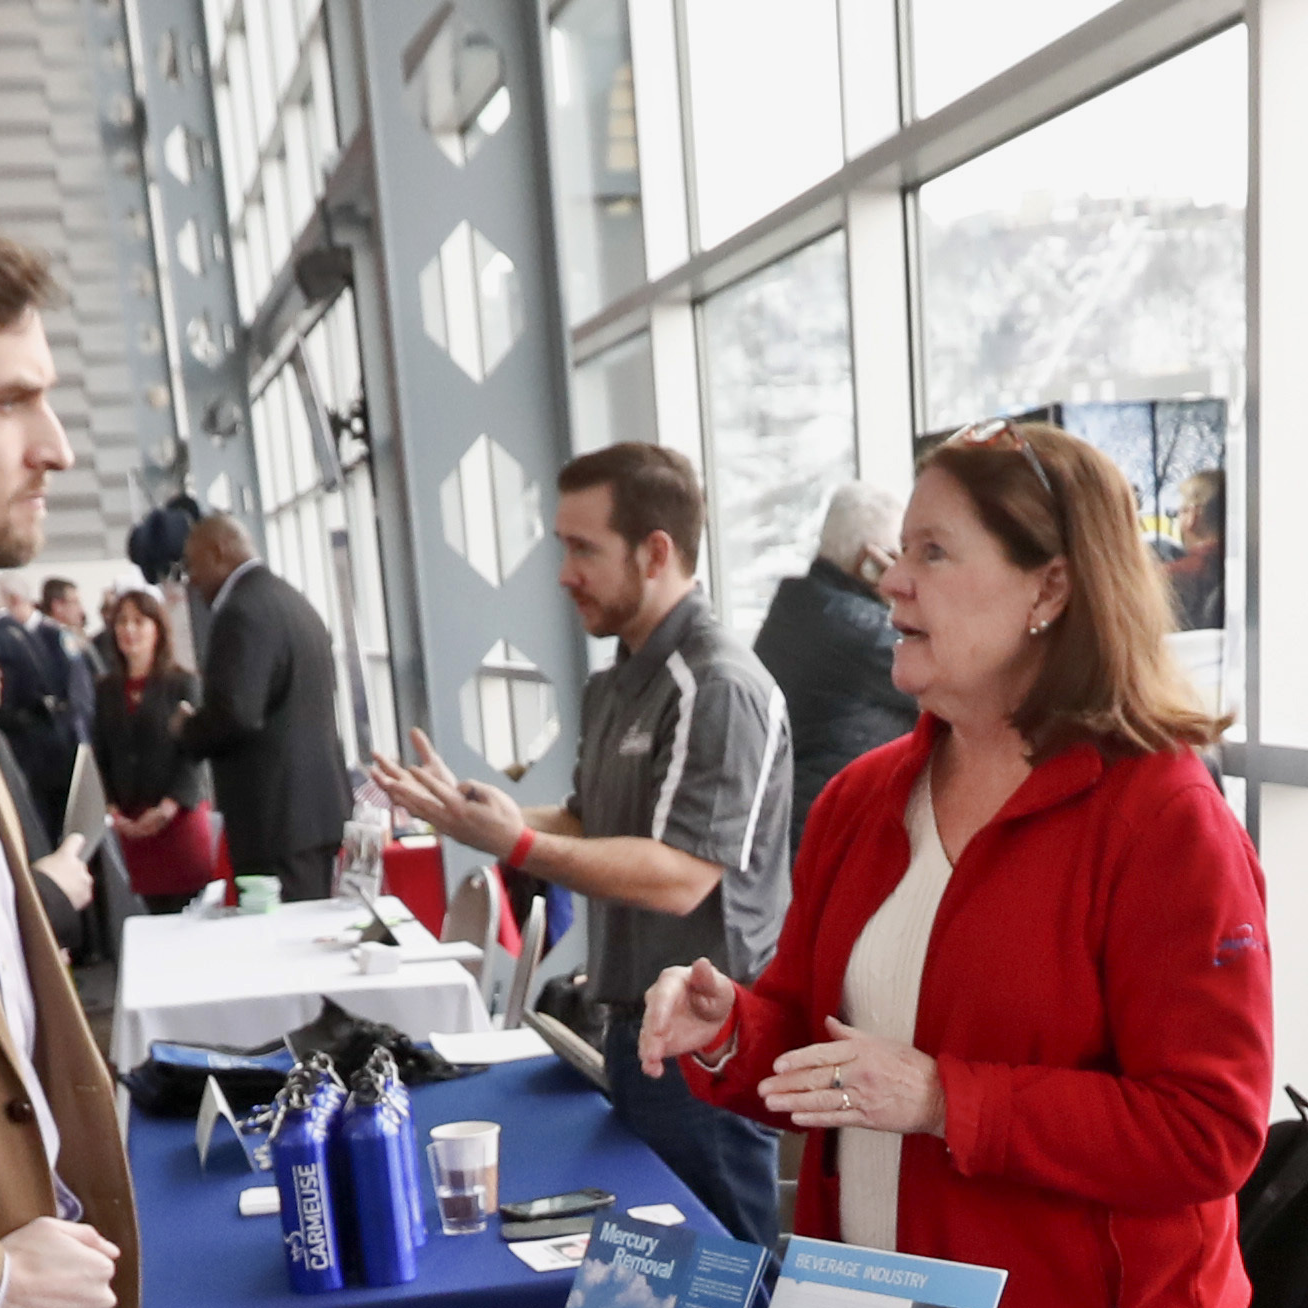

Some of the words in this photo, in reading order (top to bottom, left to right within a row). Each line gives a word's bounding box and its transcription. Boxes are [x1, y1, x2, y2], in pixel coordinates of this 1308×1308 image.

[298, 1163, 329, 1270] CARMEUSE
[599, 1221, 659, 1257] Mercury
[612, 1247, 675, 1280] Removal
[795, 1253, 860, 1279] BEVERAGE
[862, 1265, 929, 1289] INDUSTRY
